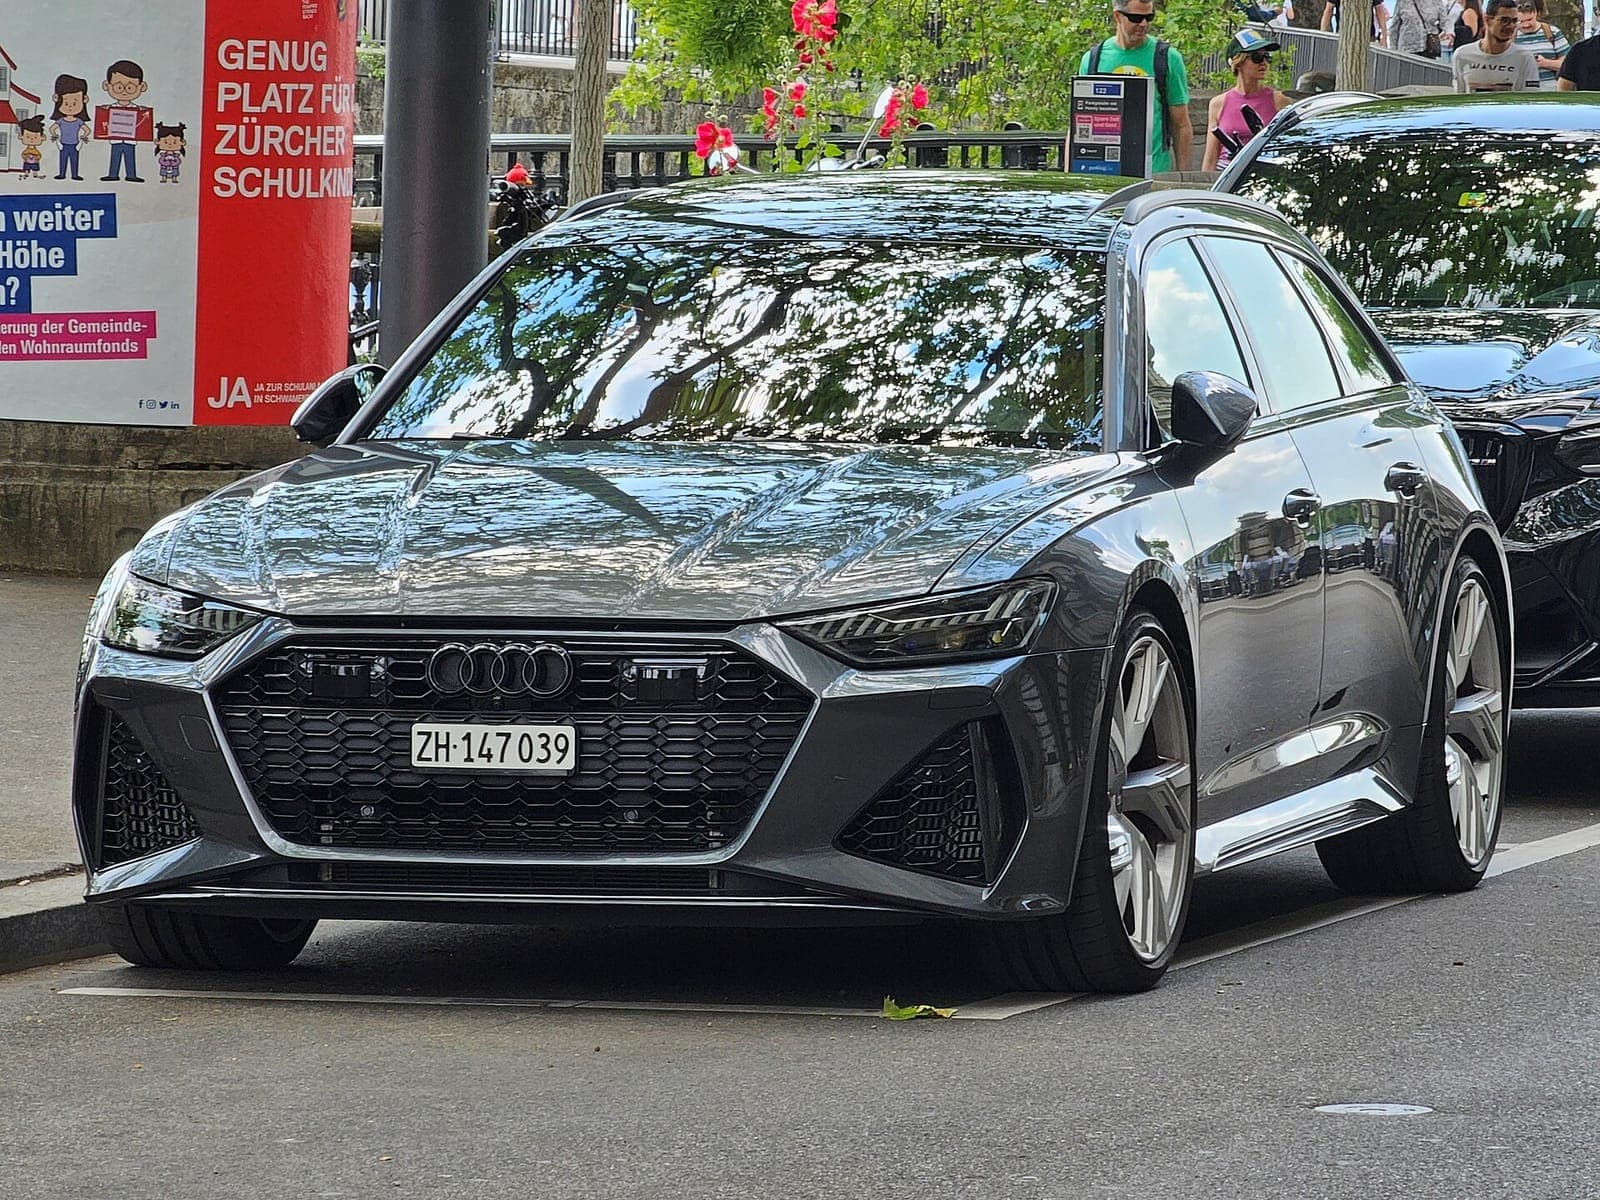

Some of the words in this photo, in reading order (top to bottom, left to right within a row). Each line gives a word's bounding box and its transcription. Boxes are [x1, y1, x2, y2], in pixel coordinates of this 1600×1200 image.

[217, 38, 327, 72] GENUG
[216, 81, 314, 114] PLATZ
[320, 75, 350, 114] FÜR
[215, 116, 346, 156] ZÜRCHER
[12, 202, 105, 232] weiter
[0, 239, 65, 269] Höhe
[41, 319, 65, 334] der
[67, 317, 148, 334] Gemeinde-
[20, 338, 139, 355] Wohnraumfonds
[207, 376, 252, 409] JA
[253, 383, 265, 392] JA
[265, 383, 283, 392] ZUR
[253, 394, 263, 403] IN
[518, 732, 570, 765] 039
